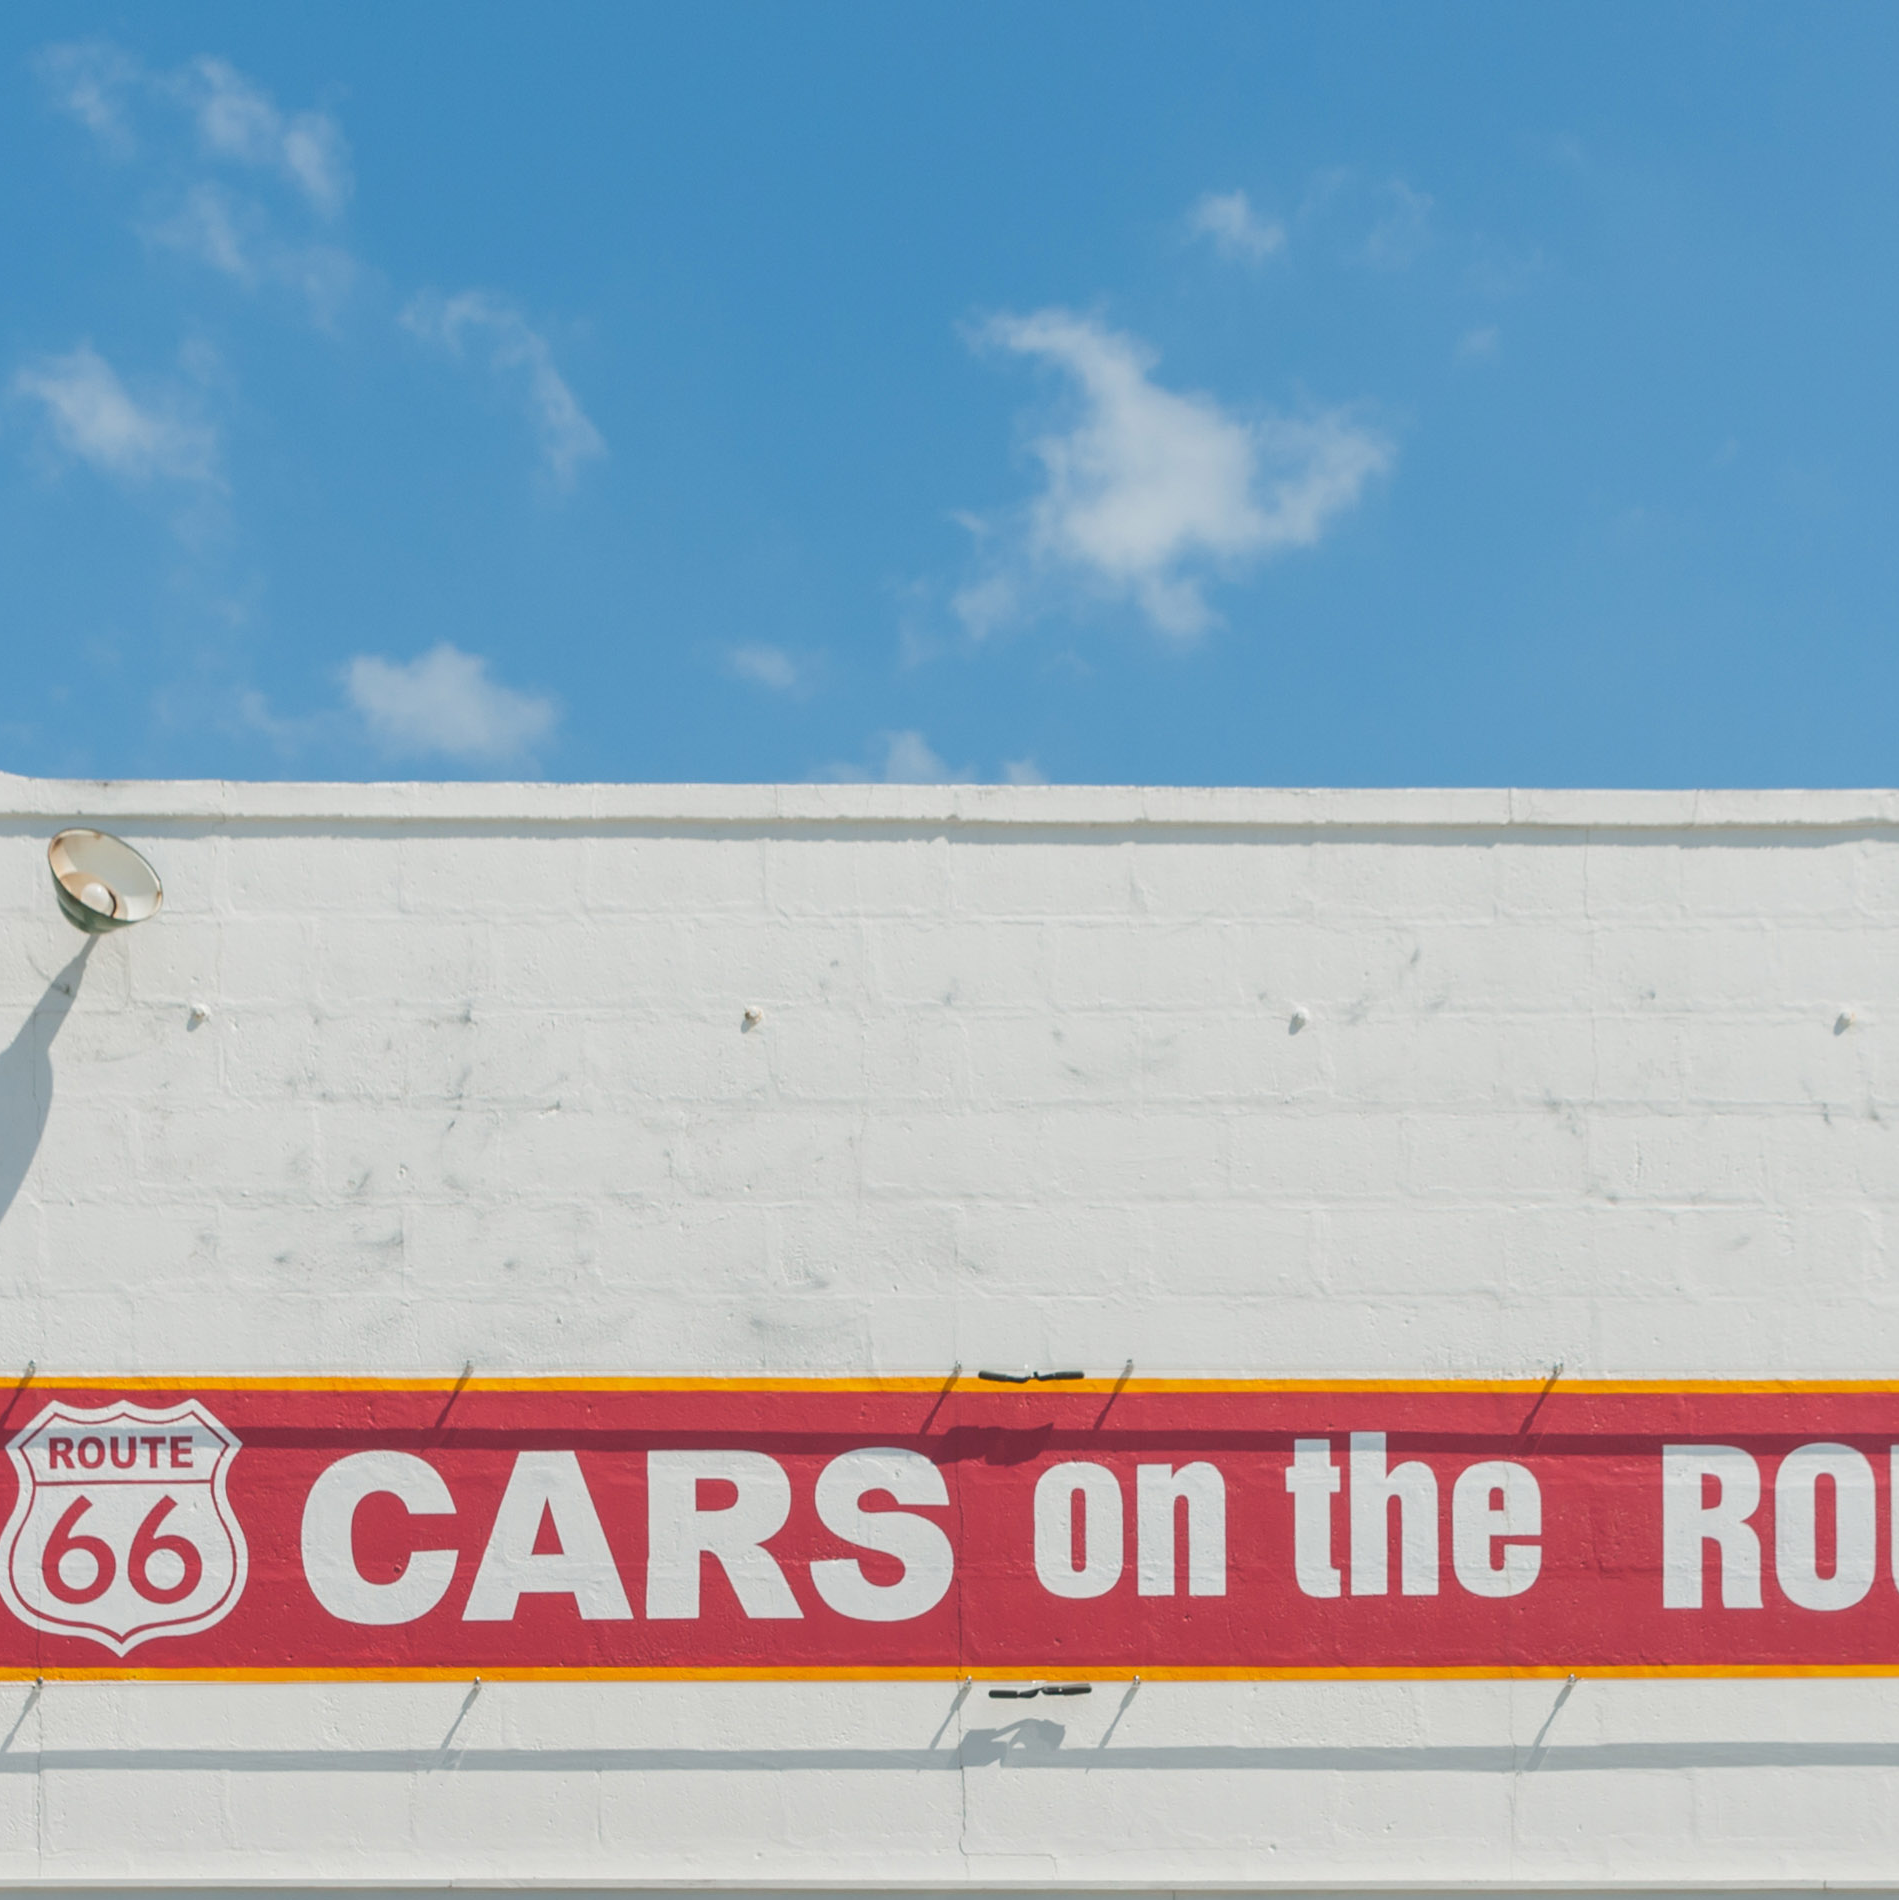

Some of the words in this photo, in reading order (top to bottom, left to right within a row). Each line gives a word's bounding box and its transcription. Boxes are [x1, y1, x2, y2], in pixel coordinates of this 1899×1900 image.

[48, 1436, 194, 1472] ROUTE
[41, 1494, 203, 1606] 66
[302, 1447, 957, 1625] CARS
[1033, 1457, 1227, 1599] on
[1286, 1431, 1543, 1600] the
